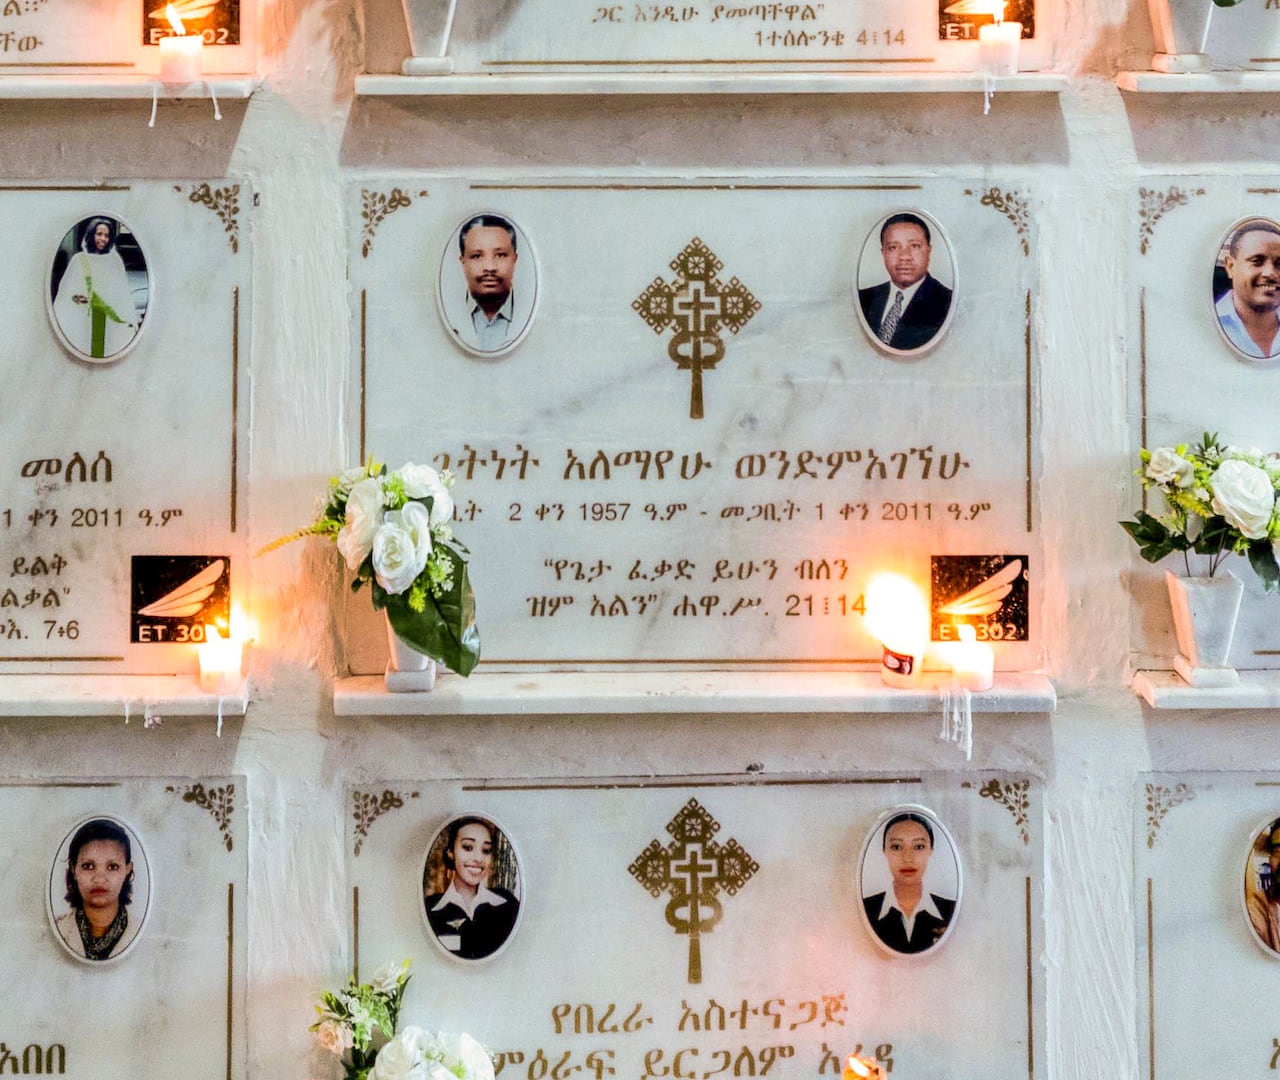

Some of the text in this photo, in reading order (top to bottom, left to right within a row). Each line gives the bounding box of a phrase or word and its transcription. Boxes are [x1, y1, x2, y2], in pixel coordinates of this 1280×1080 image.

[20, 450, 113, 484] መለሰ
[563, 445, 970, 481] አለማየሁ ወንድምአገኘሁ
[551, 993, 848, 1035] የበረራ አስተናጋጅ
[640, 1045, 795, 1080] ይርጋለም
